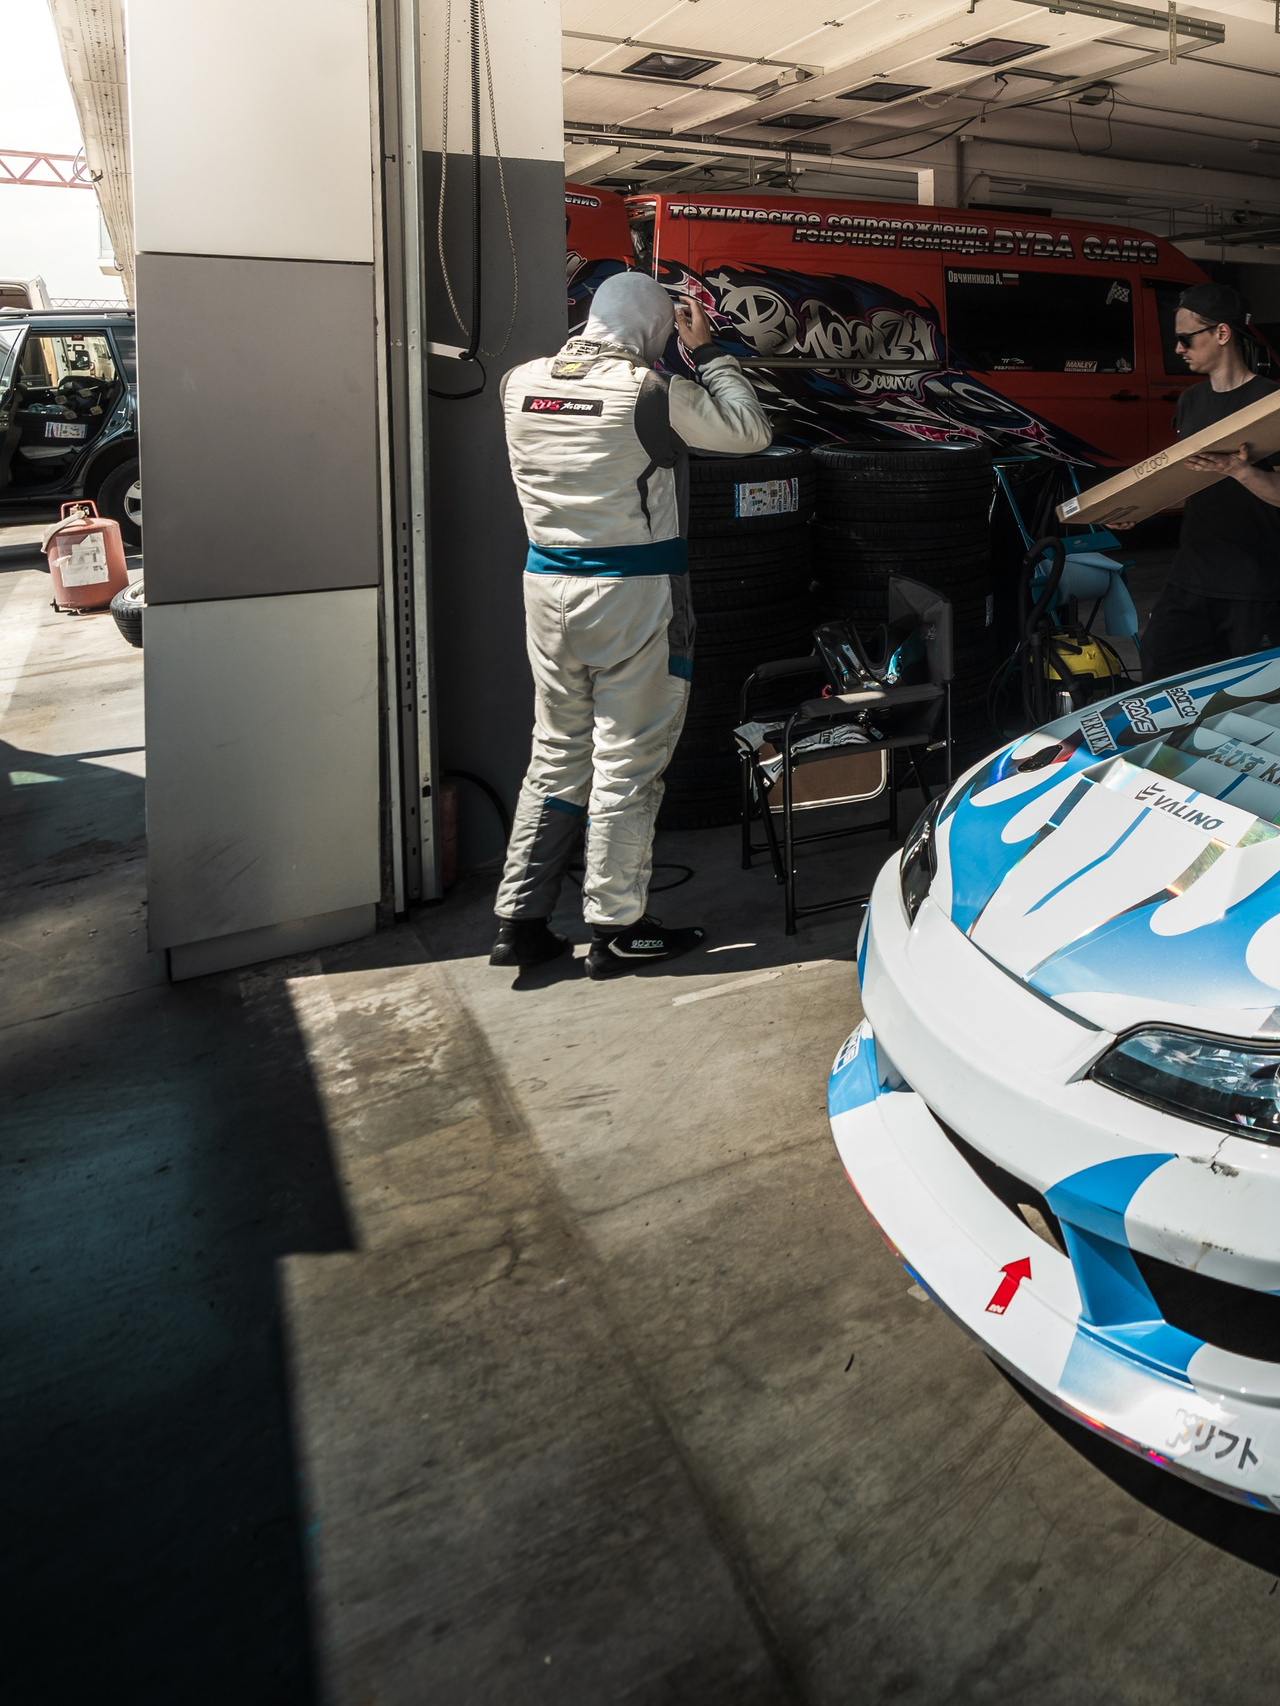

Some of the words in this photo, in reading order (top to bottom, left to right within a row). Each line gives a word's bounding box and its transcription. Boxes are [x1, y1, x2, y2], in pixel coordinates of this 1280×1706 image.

[669, 204, 820, 226] техническое
[827, 215, 989, 239] сопровождение
[795, 228, 896, 247] гоночной
[901, 234, 990, 254] команды
[1083, 236, 1158, 264] GANG
[948, 270, 994, 285] Овчинников
[1066, 361, 1094, 369] MANLEY
[529, 399, 562, 411] RDS
[1120, 698, 1159, 734] RAYS
[1167, 687, 1199, 719] sparco
[1080, 711, 1116, 755] VERTEX
[1208, 743, 1266, 774] えびす
[1153, 794, 1225, 831] VALINO
[631, 940, 664, 949] sparco
